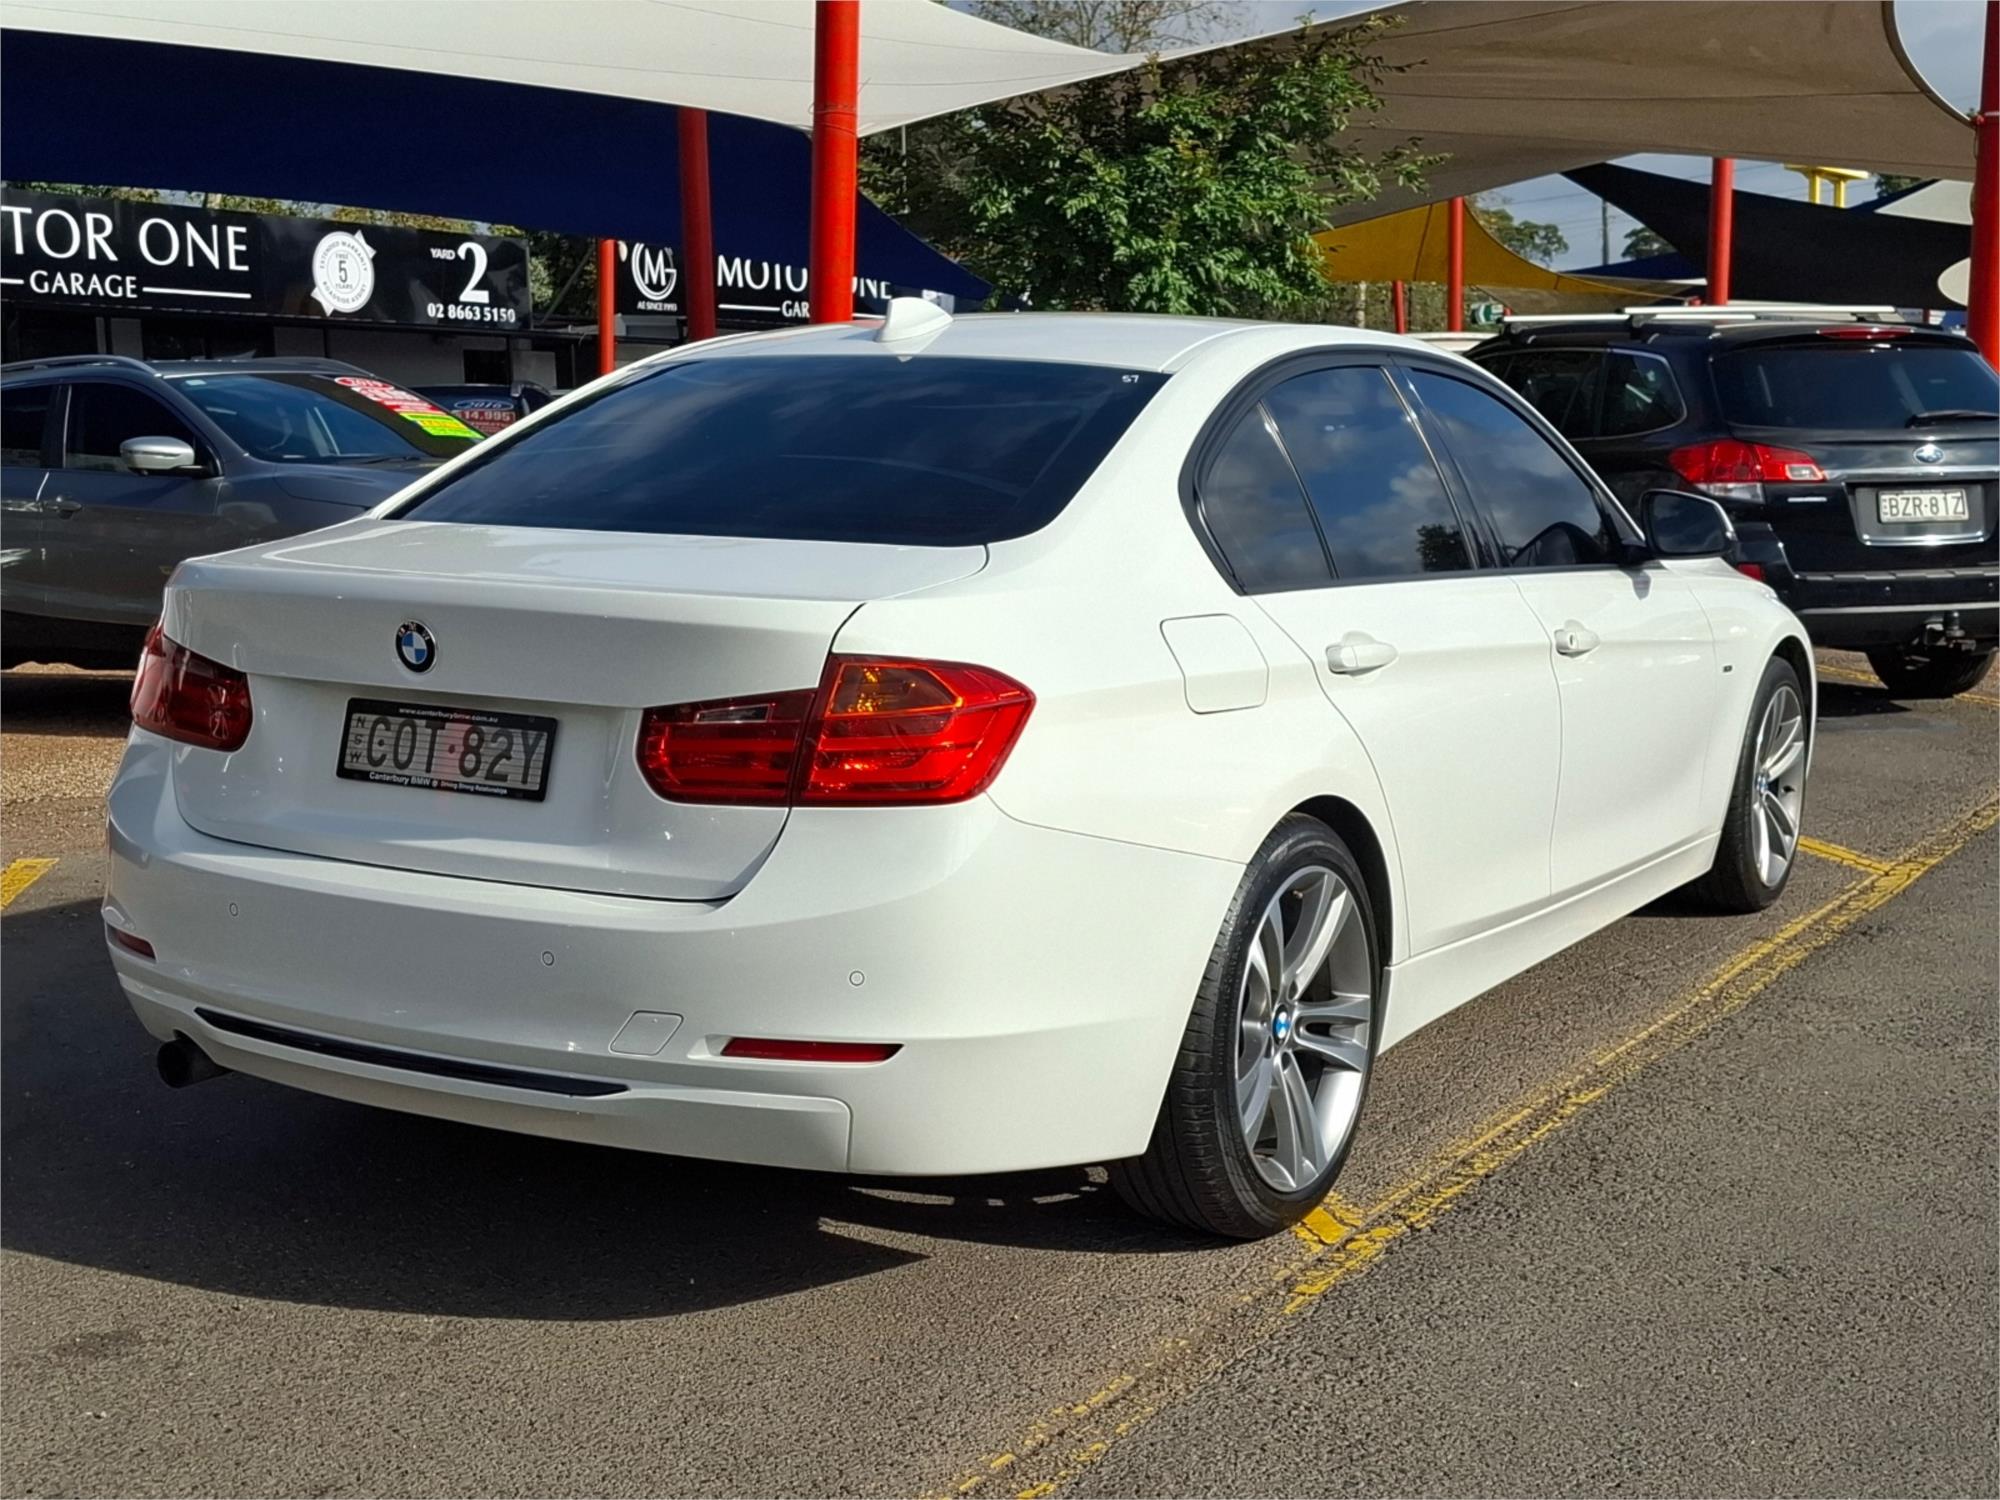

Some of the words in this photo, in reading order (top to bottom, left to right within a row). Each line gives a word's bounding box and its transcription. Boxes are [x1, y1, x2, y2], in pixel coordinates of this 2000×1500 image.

[0, 205, 119, 261] TOR
[138, 217, 249, 271] ONE
[29, 269, 138, 298] GARAGE
[338, 260, 348, 283] 5
[430, 248, 456, 261] YARD
[457, 241, 490, 304] 2
[717, 254, 808, 292] MOTO
[427, 303, 444, 319] 02
[447, 304, 481, 321] 8663
[483, 307, 516, 323] 5150
[782, 300, 810, 318] GAR
[368, 771, 410, 786] Canterbury
[410, 776, 431, 787] BMW
